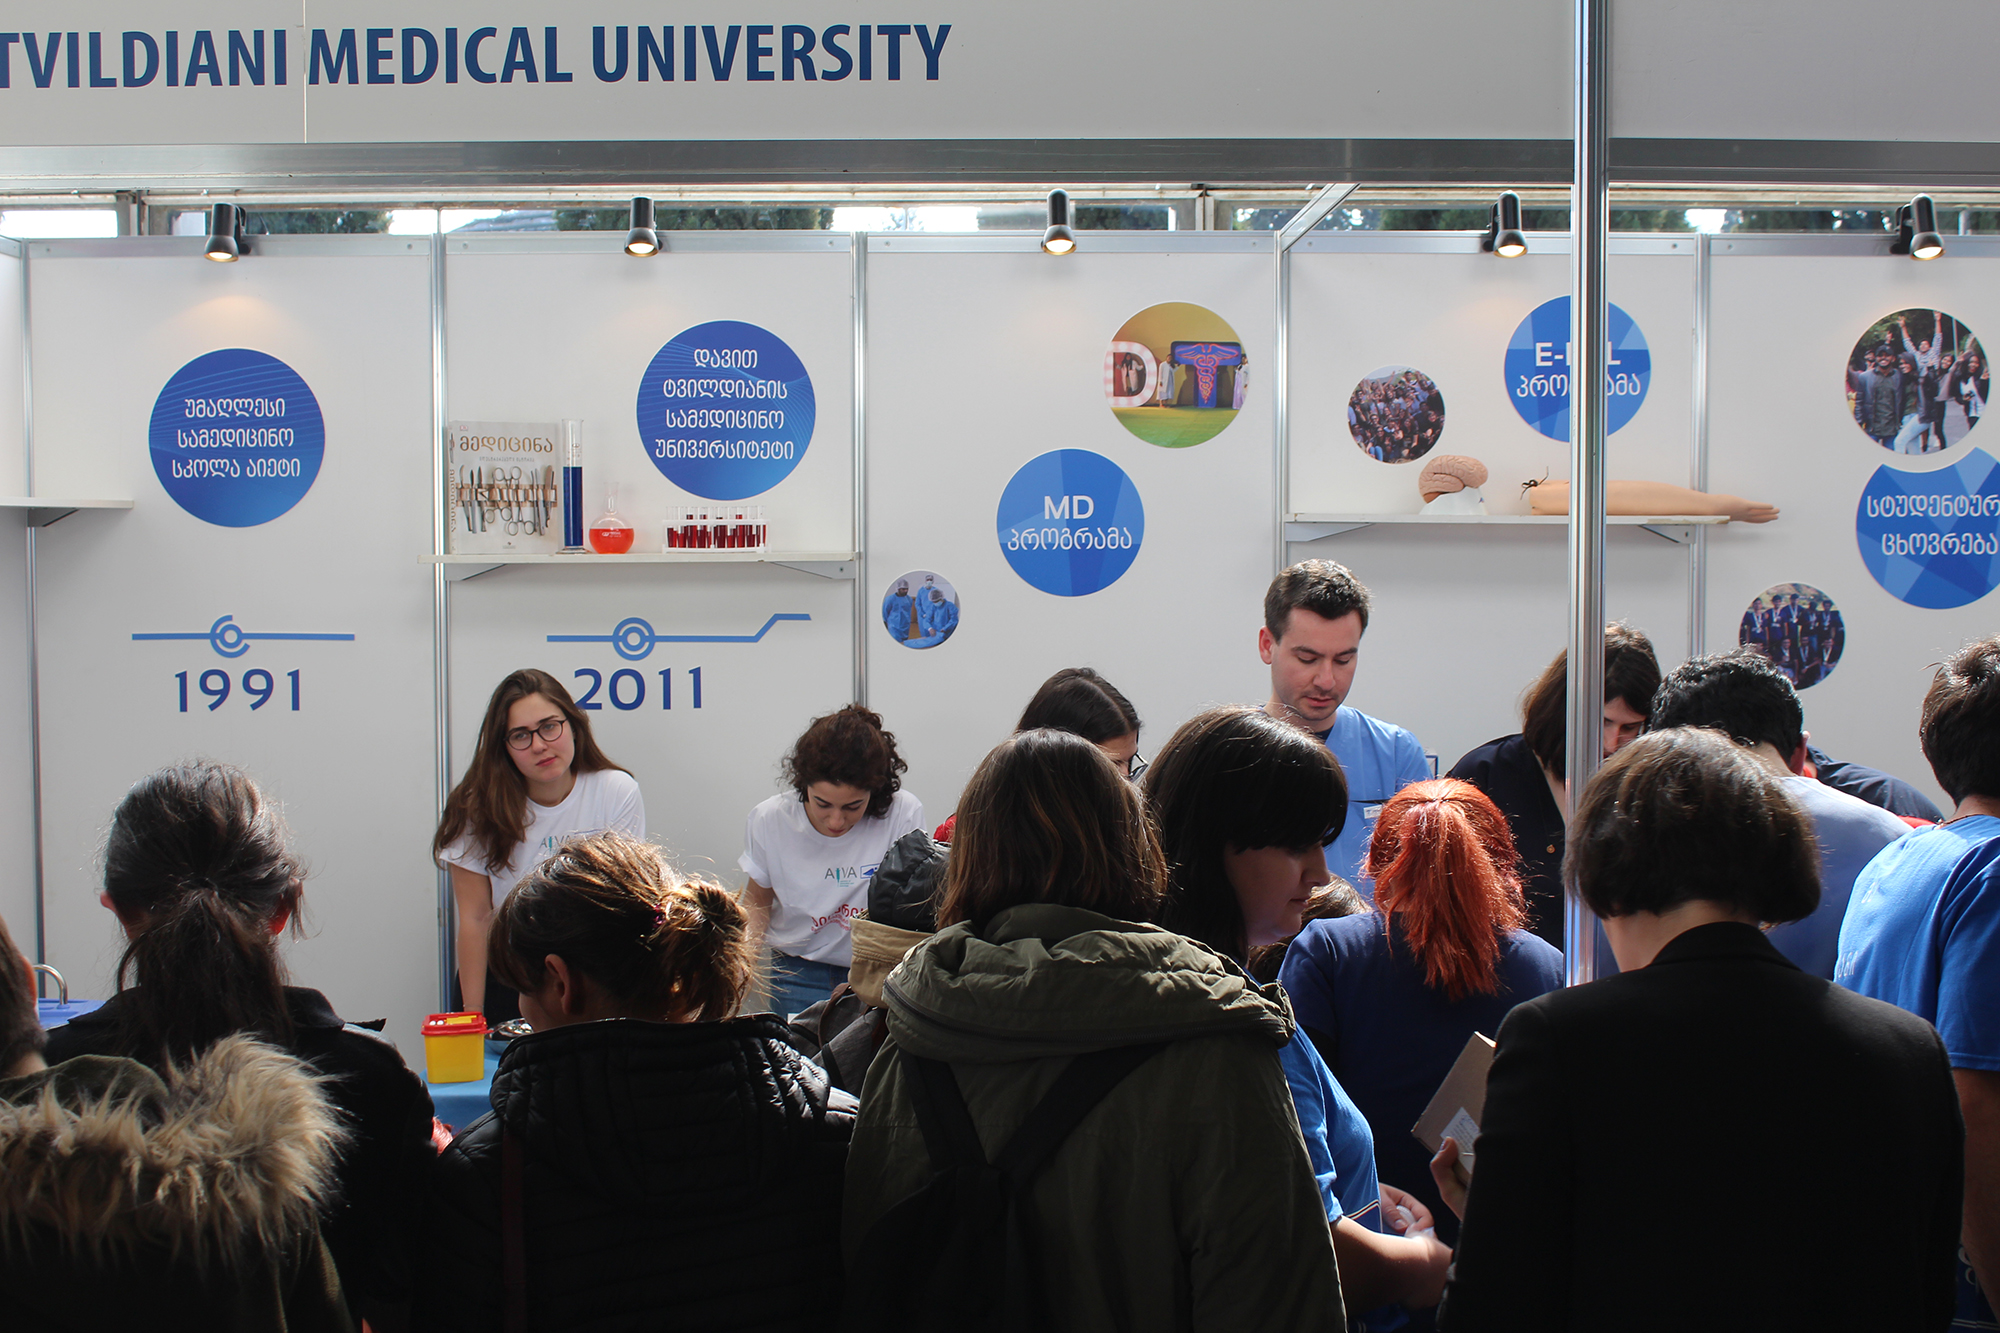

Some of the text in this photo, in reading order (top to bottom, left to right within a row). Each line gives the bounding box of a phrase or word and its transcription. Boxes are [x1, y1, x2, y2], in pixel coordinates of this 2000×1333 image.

[0, 24, 953, 89] TVILDIANI MEDICAL UNIVERSITY
[692, 347, 759, 368] დავით
[1534, 340, 1622, 367] E-L
[662, 378, 788, 400] ტვილდიანის
[1516, 373, 1642, 398] პროამა
[184, 397, 286, 419] უმაღლესი
[665, 408, 785, 431] სამედიცინო
[177, 427, 294, 449] სამედიცინო
[459, 435, 554, 453] მედიცინა
[654, 437, 795, 461] უნივერსიტეტი
[172, 457, 301, 479] სკოლა აიეტი
[1044, 495, 1095, 520] MD
[1007, 526, 1133, 551] პროგრამა
[1881, 532, 1999, 556] ცხოვრება
[174, 667, 300, 713] 1991
[573, 666, 702, 711] 2011
